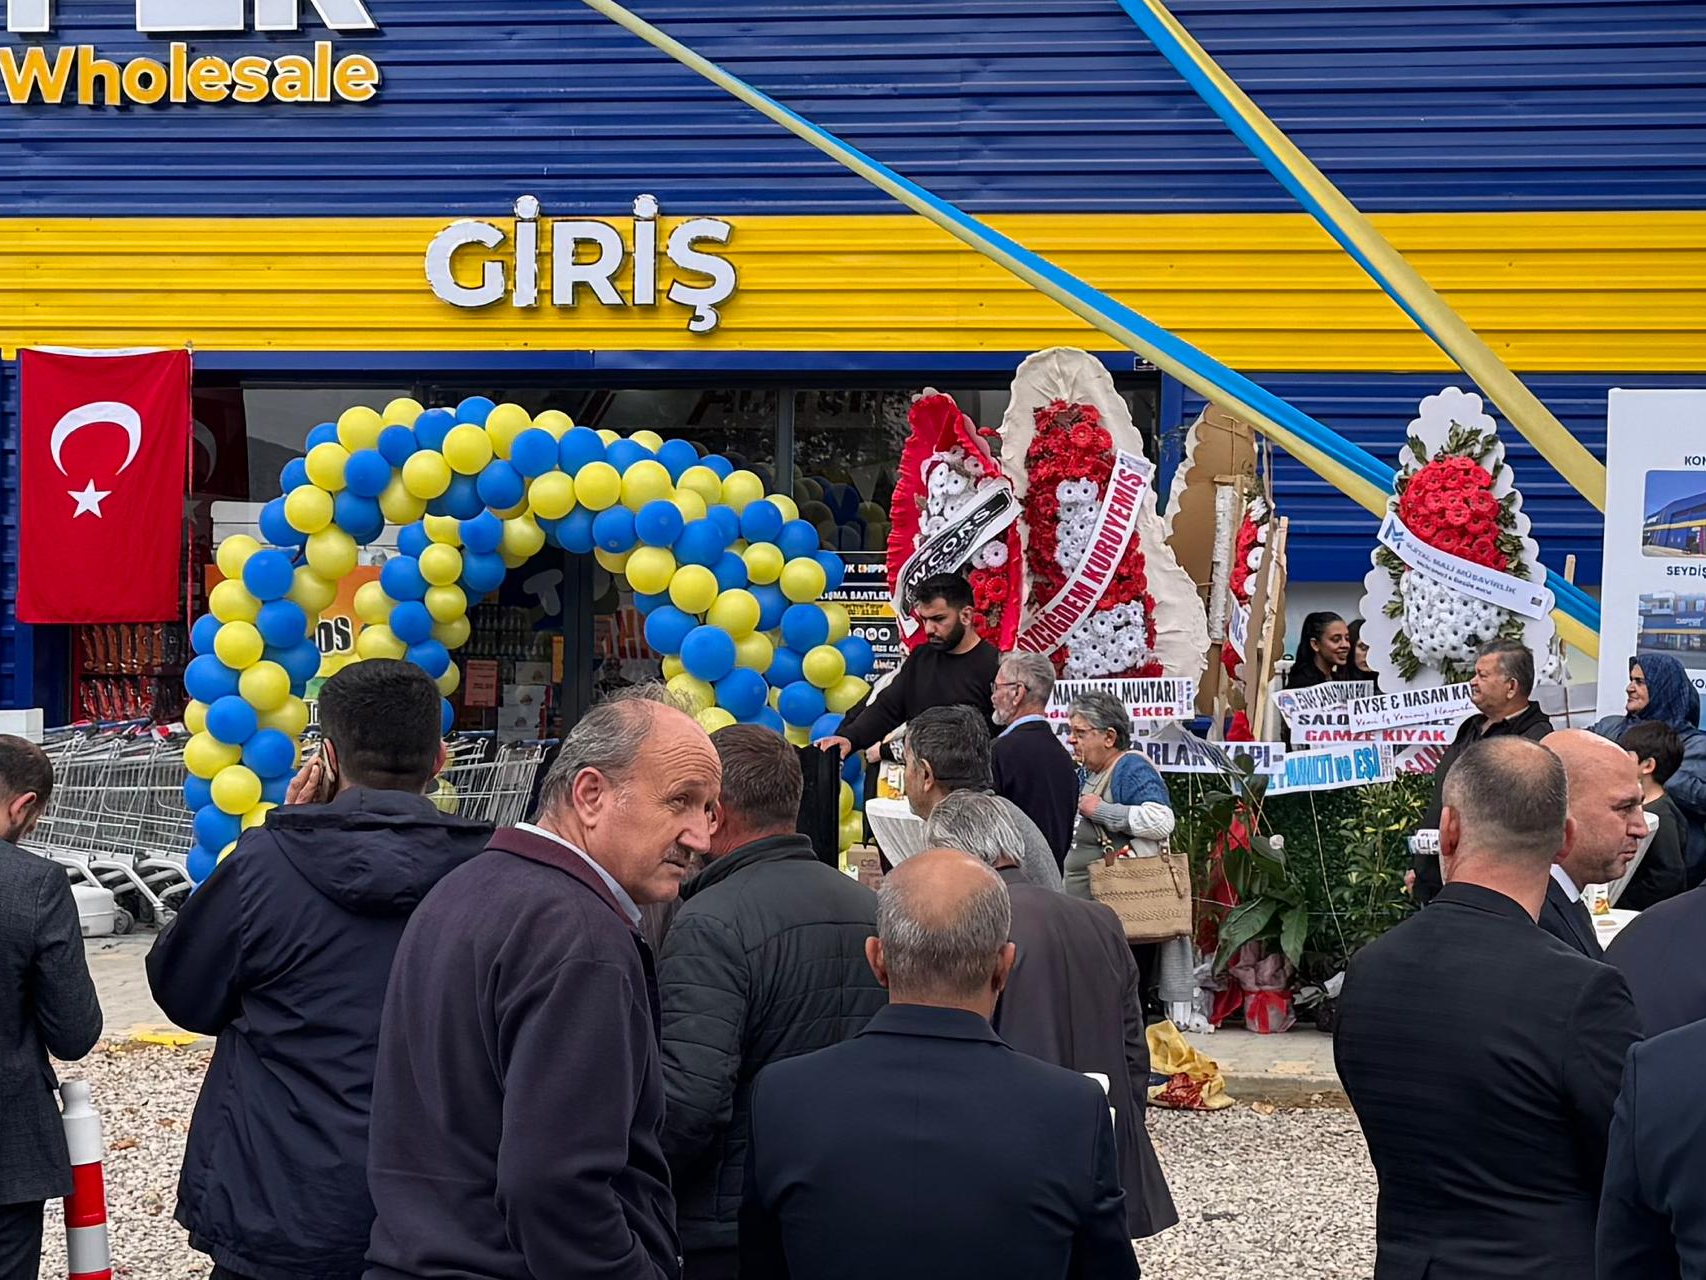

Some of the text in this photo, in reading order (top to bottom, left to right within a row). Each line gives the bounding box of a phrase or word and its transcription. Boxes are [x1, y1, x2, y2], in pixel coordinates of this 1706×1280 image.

[425, 194, 737, 333] GİRİŞ
[1081, 468, 1147, 586] KURUYEMİŞ
[1354, 696, 1388, 715] AYŞE
[1403, 687, 1449, 708] HASAN
[1132, 707, 1174, 717] EKER
[1298, 714, 1349, 726] SALO
[1305, 729, 1446, 742] GAMZE KIYAK
